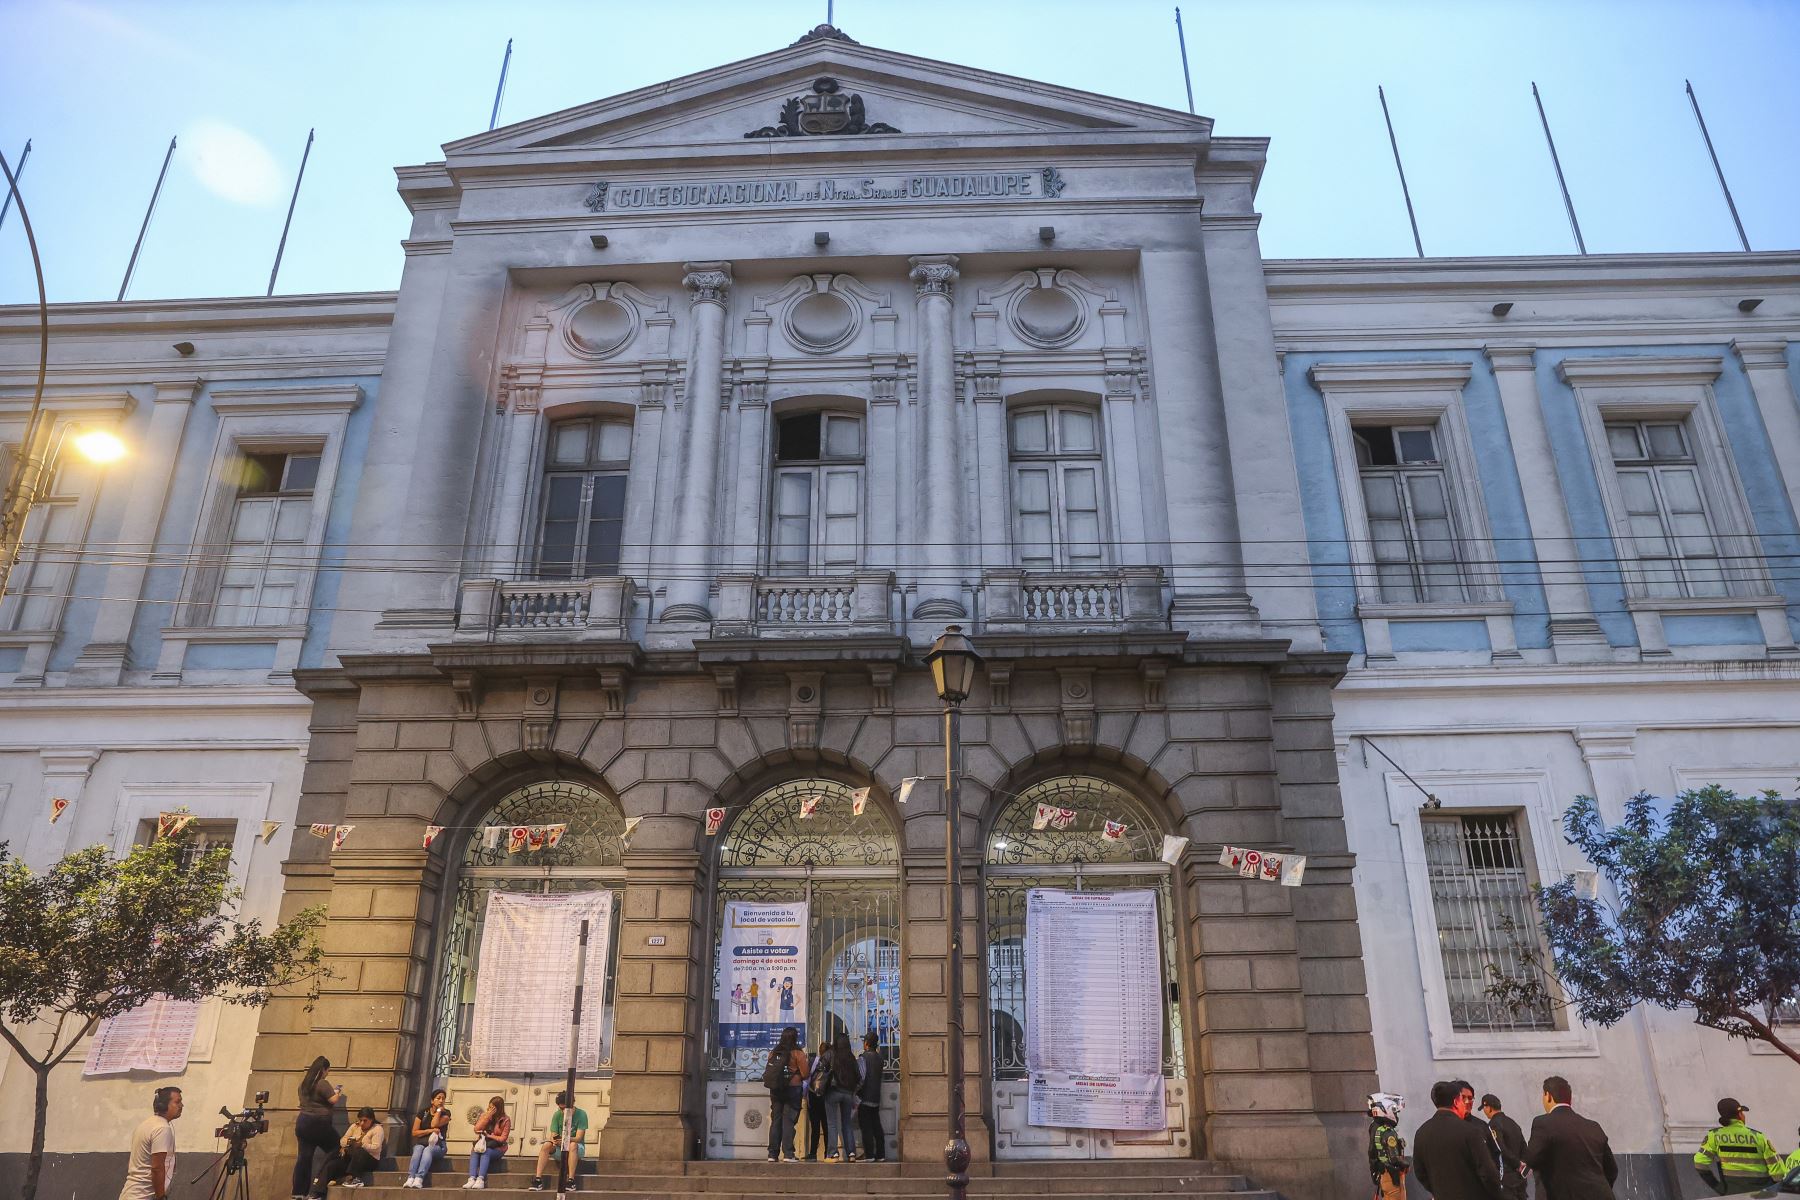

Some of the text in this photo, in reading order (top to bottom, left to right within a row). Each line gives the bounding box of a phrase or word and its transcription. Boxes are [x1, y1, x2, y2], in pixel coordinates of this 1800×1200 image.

[615, 184, 701, 207] COLEGIO
[706, 180, 803, 205] NACIONAL
[910, 173, 1032, 197] GUADALUPE
